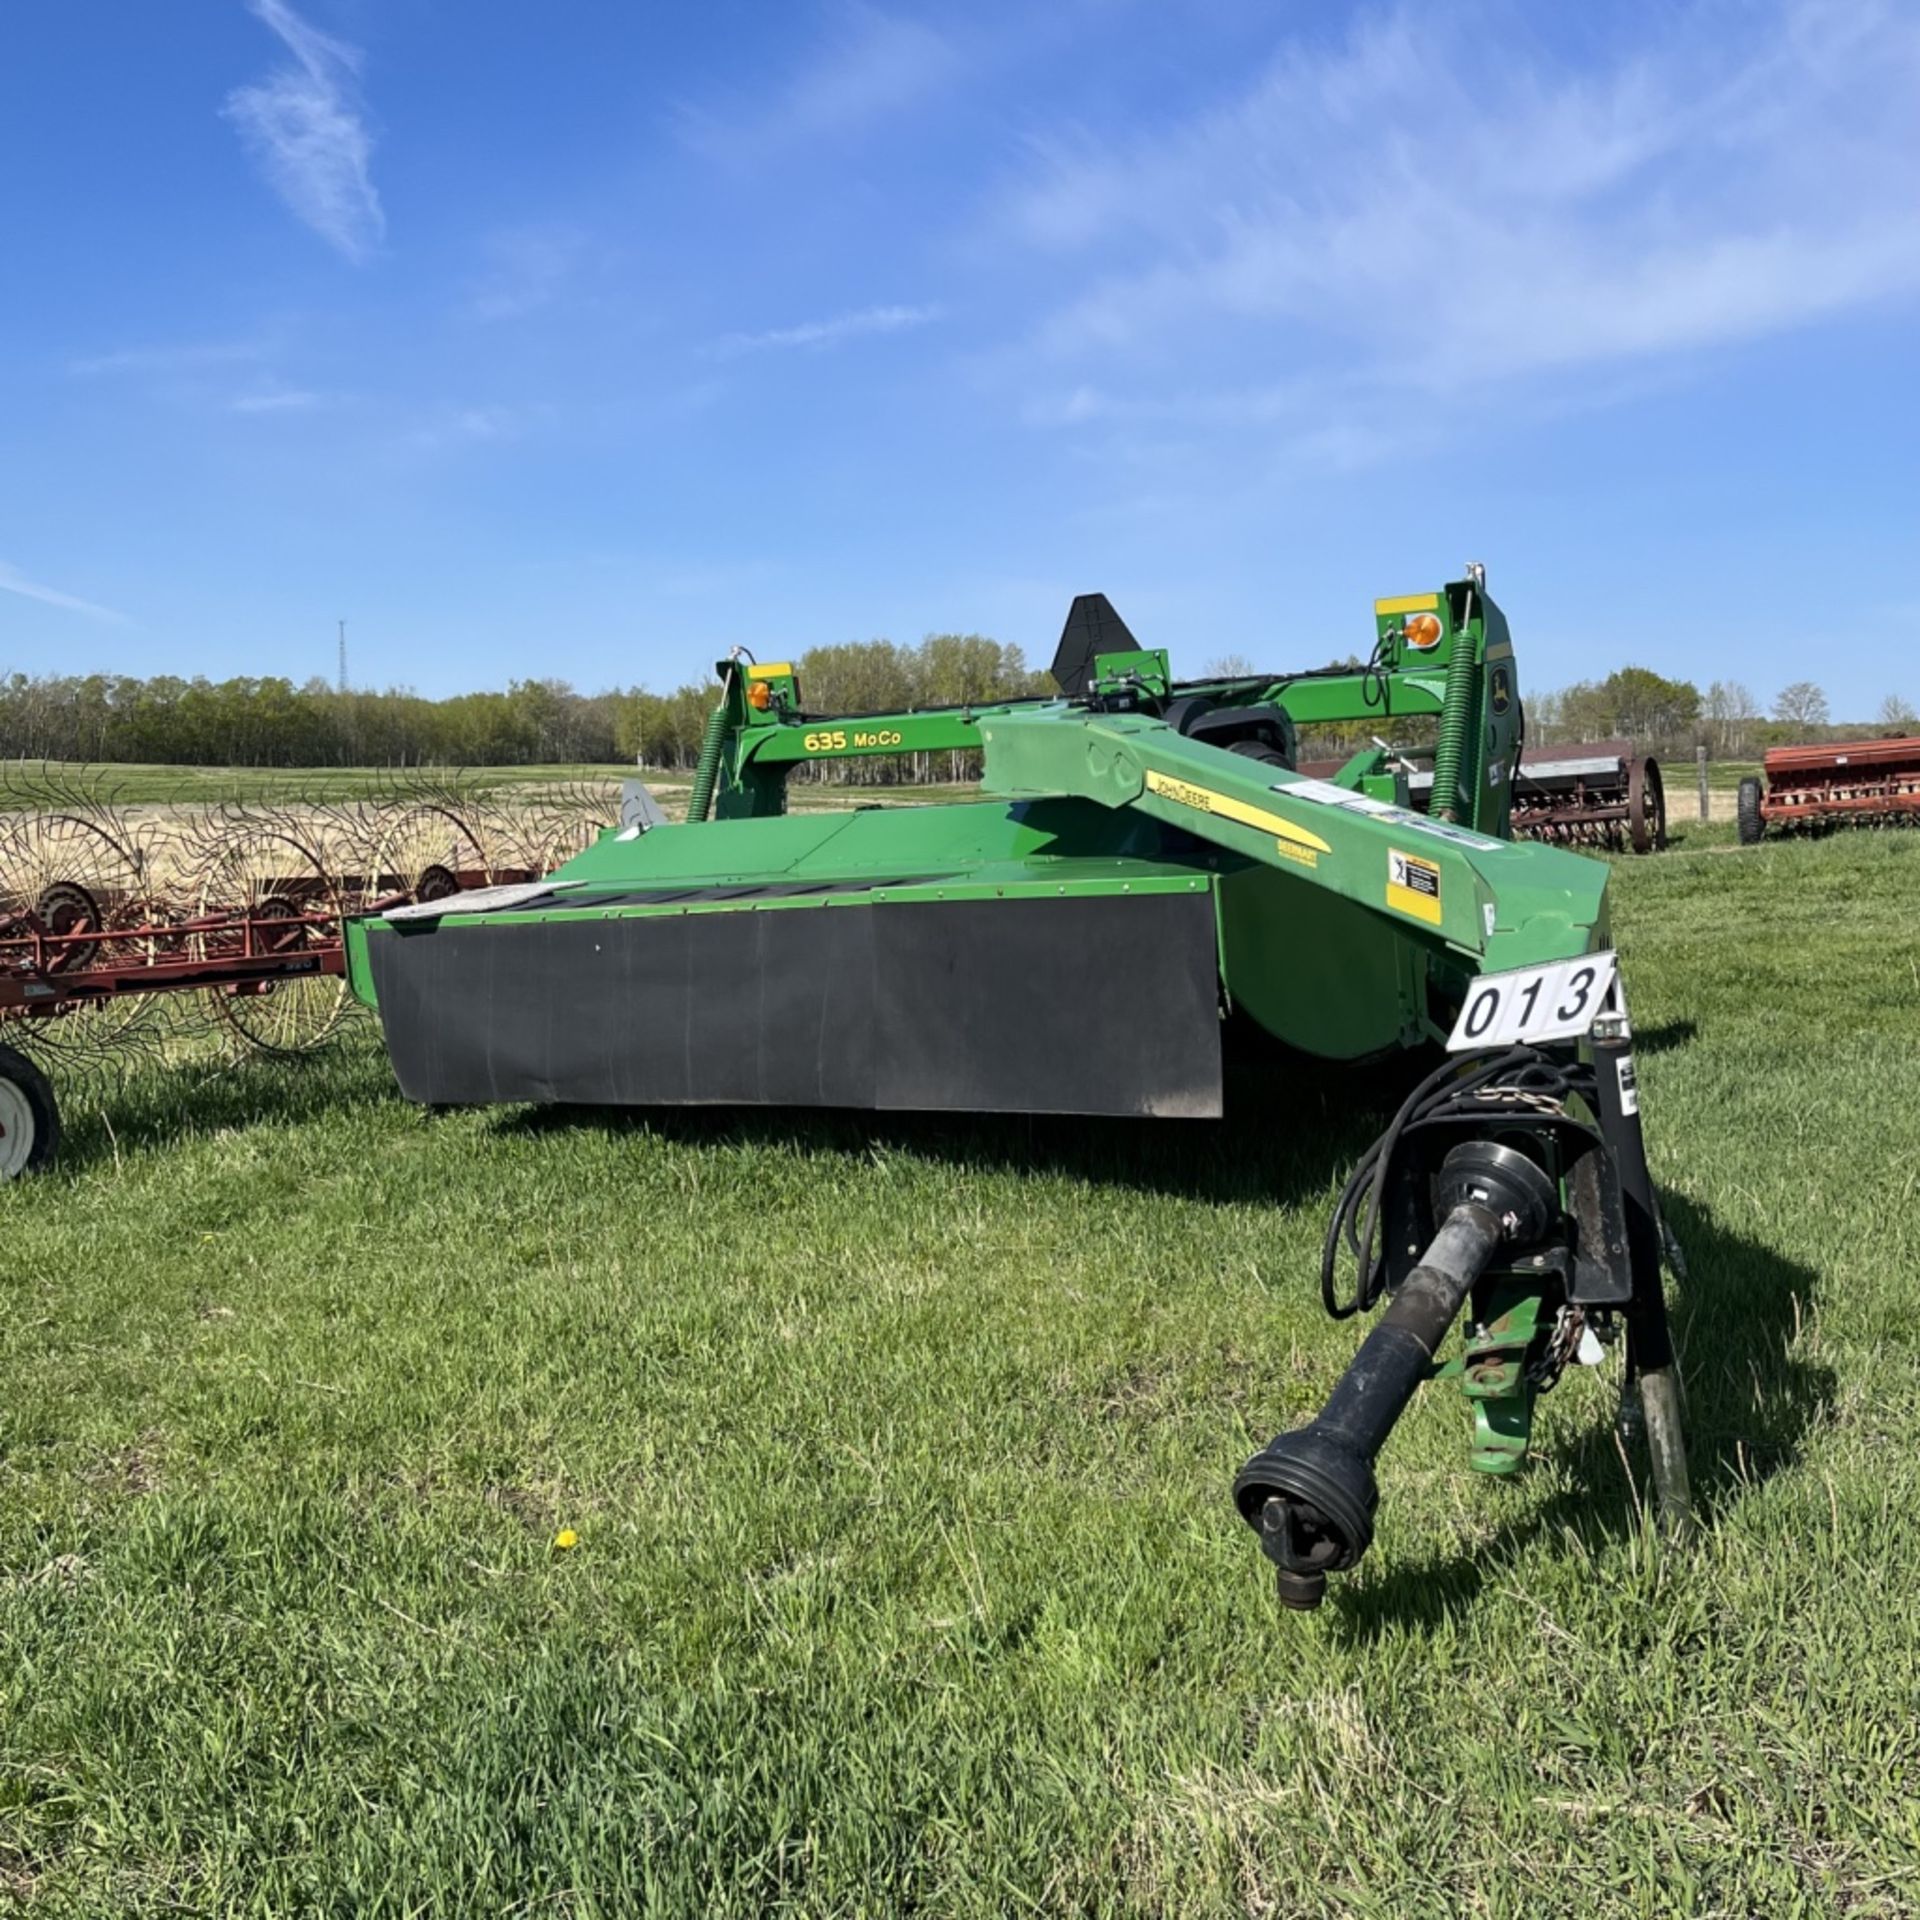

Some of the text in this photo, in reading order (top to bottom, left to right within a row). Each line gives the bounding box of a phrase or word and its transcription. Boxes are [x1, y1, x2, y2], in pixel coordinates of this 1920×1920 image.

[804, 730, 901, 752] 635 MoCo
[1465, 967, 1596, 1039] 013
